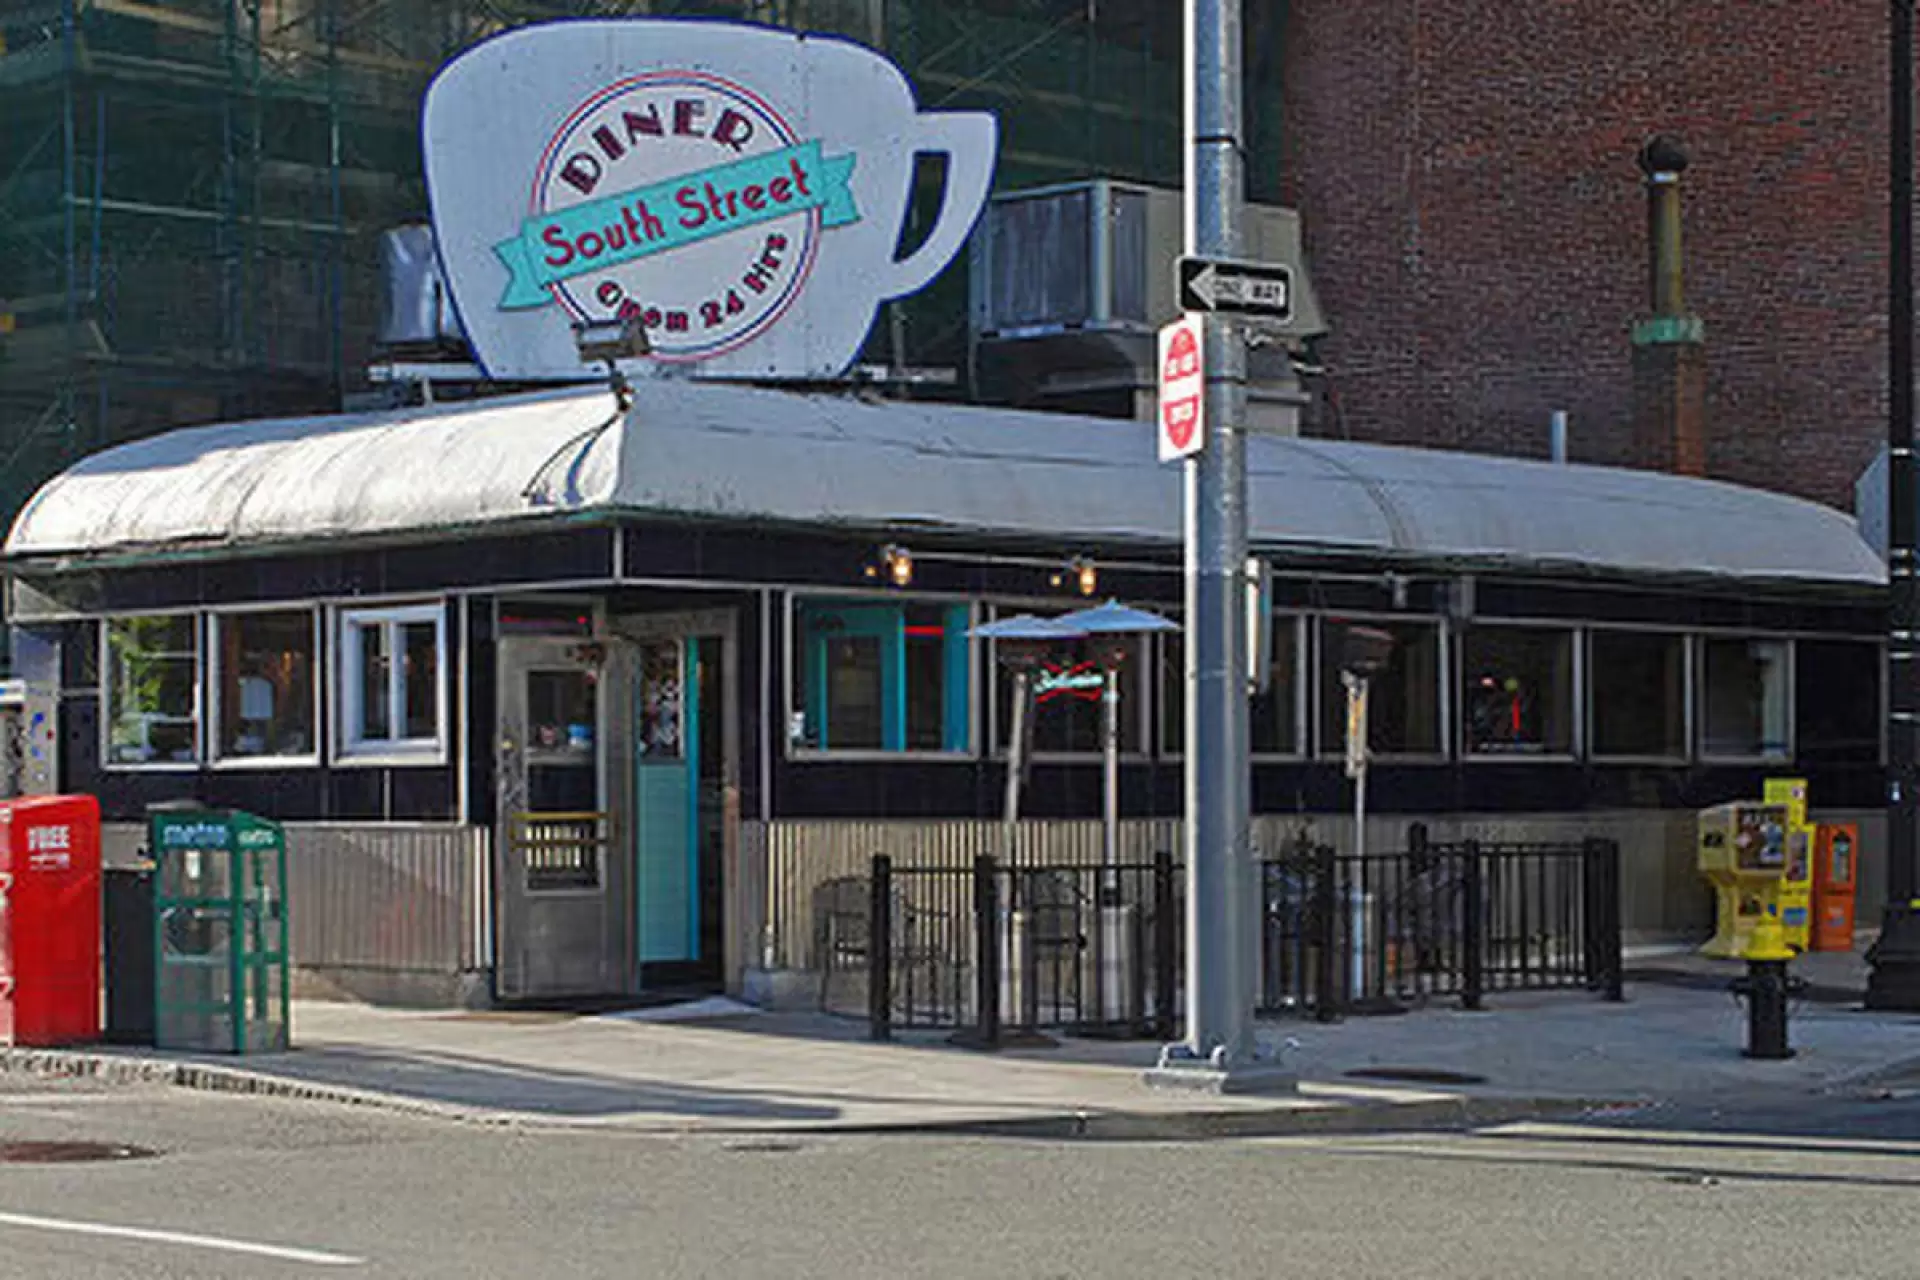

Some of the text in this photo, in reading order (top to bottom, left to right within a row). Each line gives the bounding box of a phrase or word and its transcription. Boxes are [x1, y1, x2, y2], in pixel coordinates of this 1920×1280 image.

[559, 99, 754, 194] DINER
[542, 158, 811, 267] South Street
[700, 288, 746, 329] 24
[742, 234, 788, 294] Hrs
